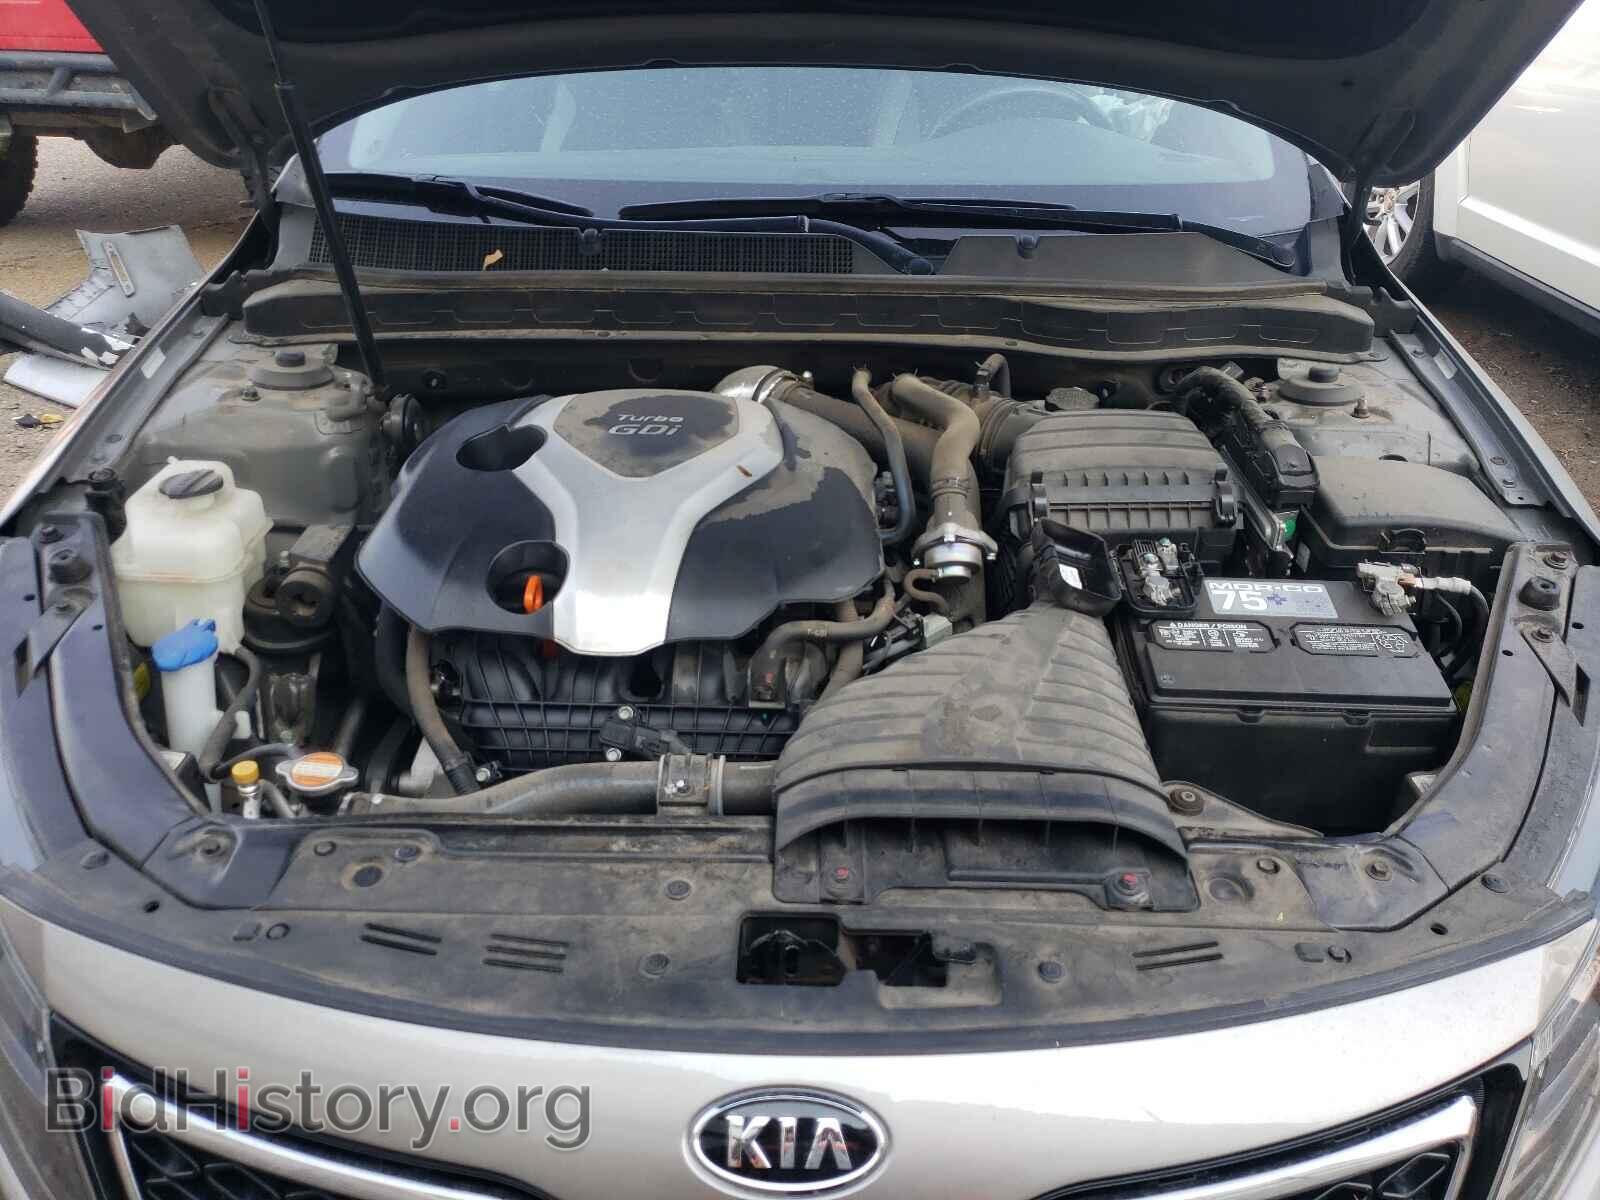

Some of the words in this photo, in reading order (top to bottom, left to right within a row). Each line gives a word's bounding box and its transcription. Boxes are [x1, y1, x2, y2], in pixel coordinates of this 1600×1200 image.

[618, 414, 684, 422] Turbo
[608, 424, 681, 435] GDi
[1211, 590, 1267, 610] 75
[726, 1115, 852, 1169] KIA
